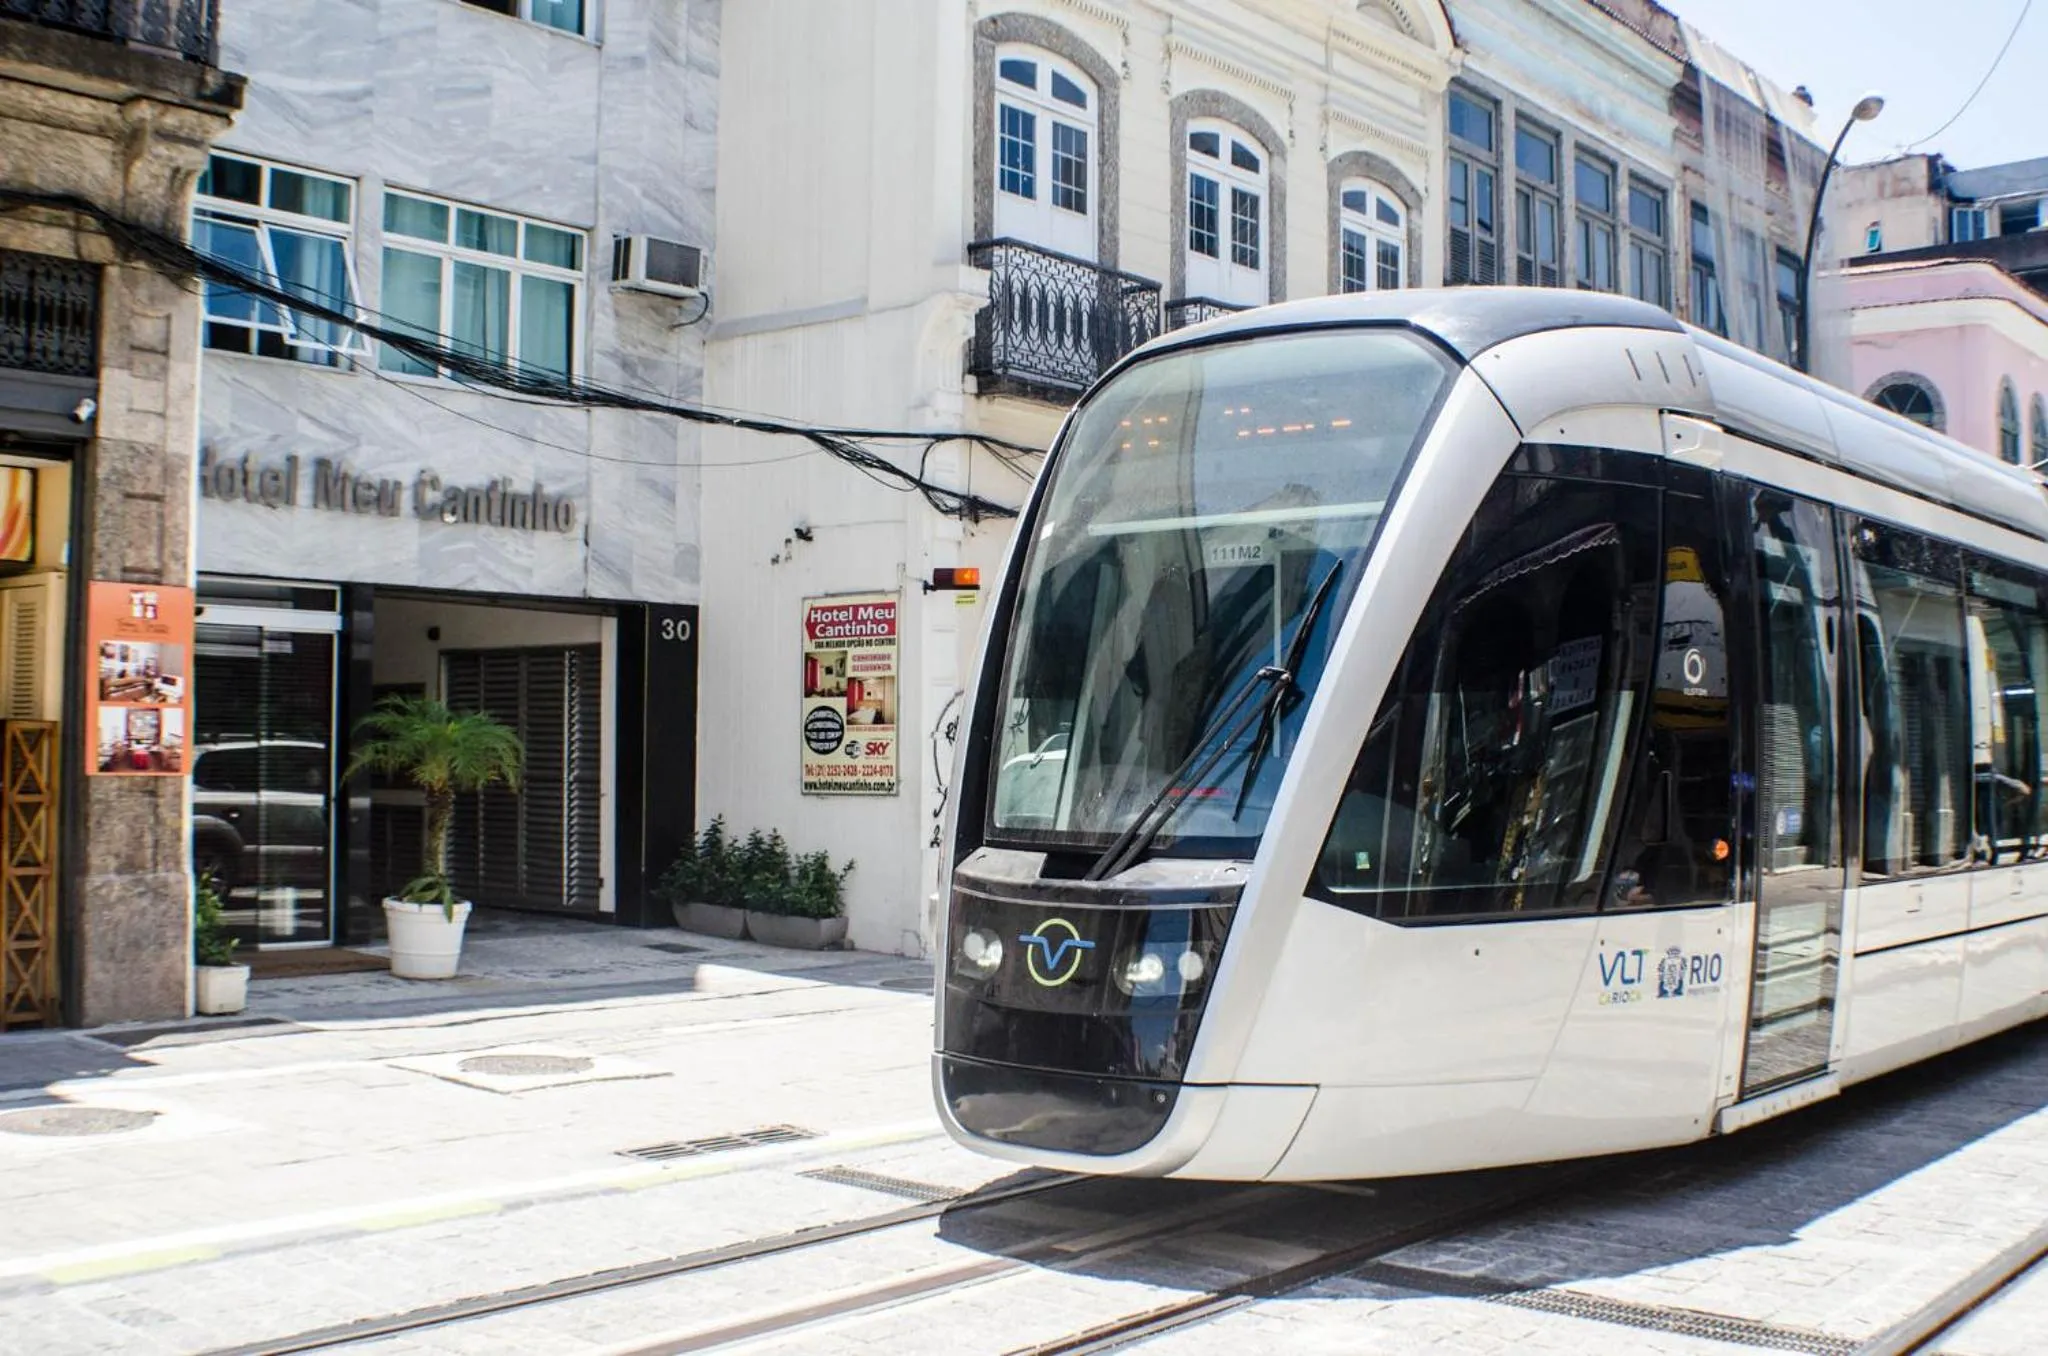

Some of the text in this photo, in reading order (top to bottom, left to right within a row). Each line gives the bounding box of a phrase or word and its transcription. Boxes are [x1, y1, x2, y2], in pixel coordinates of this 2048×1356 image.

[313, 456, 401, 517] Meu
[414, 467, 575, 533] Cantinho
[1213, 545, 1261, 561] 111M2
[811, 606, 895, 623] Hotel Meu
[662, 618, 690, 640] 30
[815, 620, 889, 637] Cantinho
[864, 742, 890, 756] SKY
[1599, 950, 1649, 986] VLT
[1690, 954, 1722, 985] RIO
